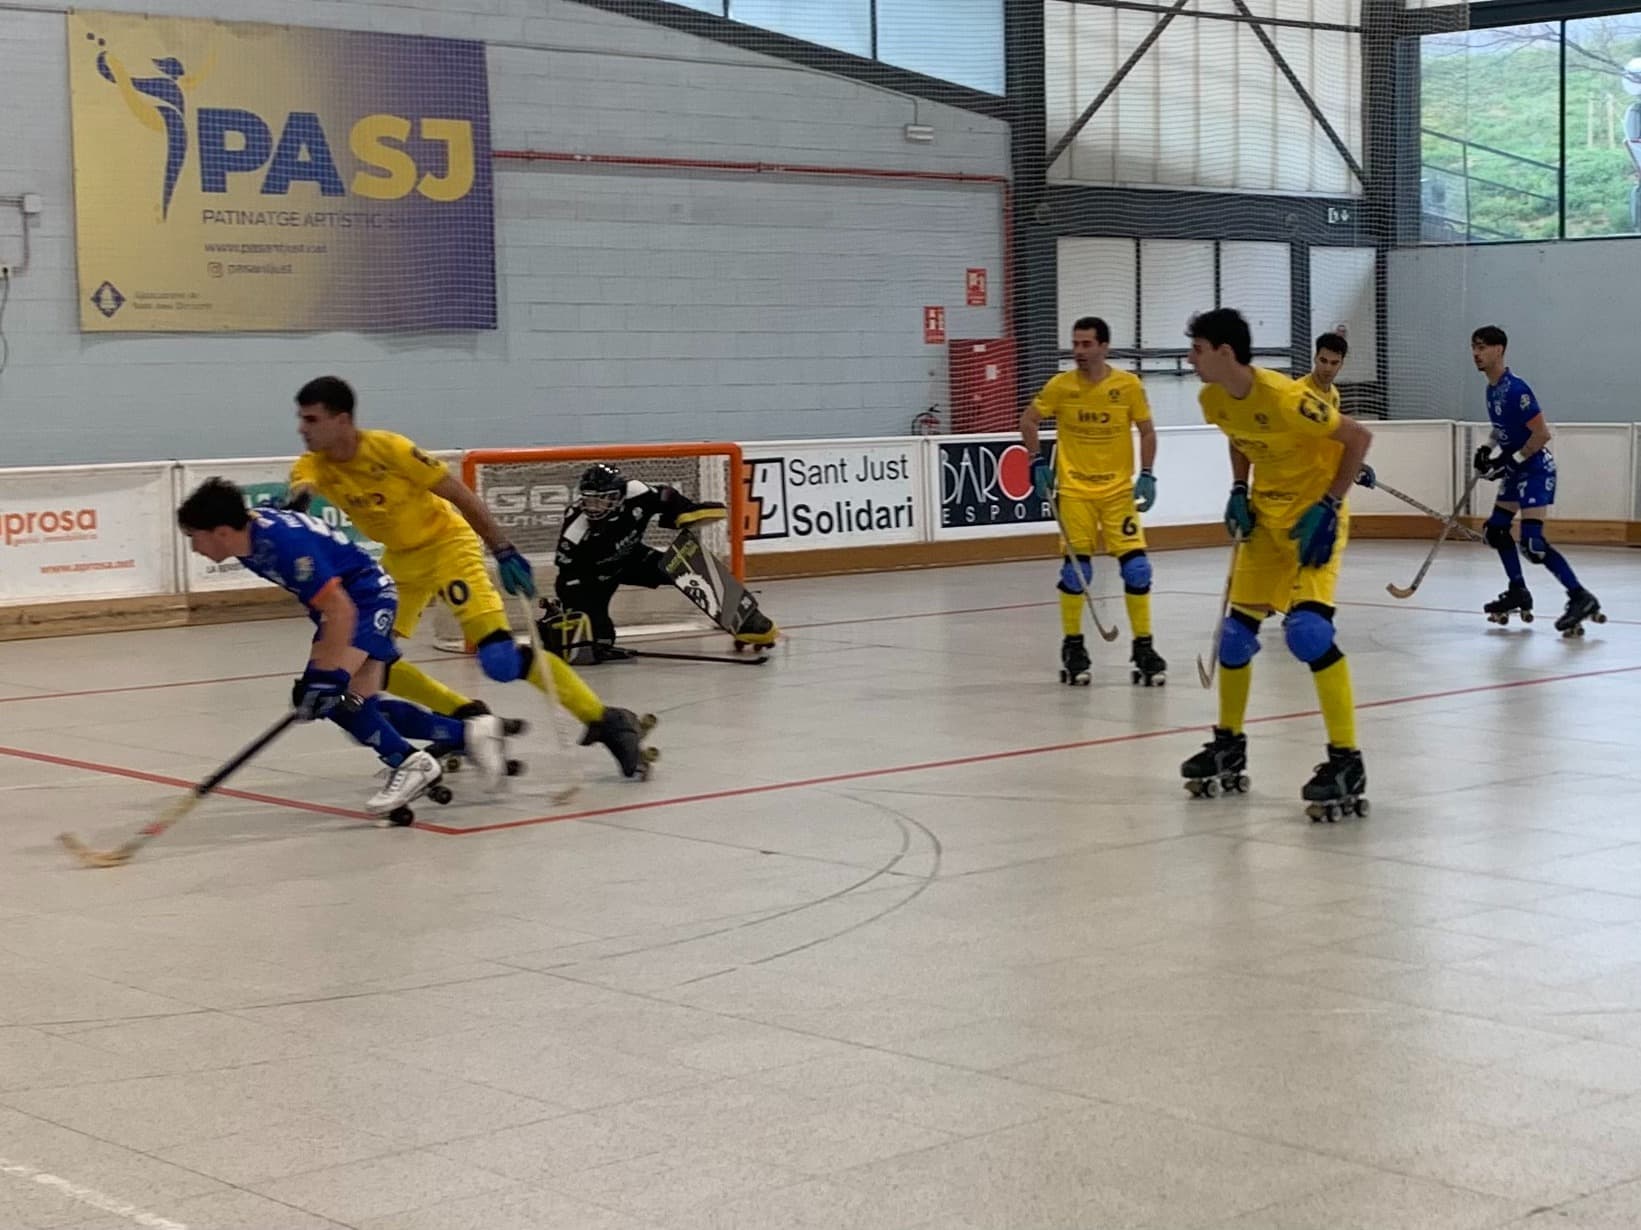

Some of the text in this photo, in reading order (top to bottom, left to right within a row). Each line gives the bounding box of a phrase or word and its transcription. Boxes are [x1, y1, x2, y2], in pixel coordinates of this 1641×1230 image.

[198, 108, 476, 202] PASJ
[202, 208, 299, 227] PATINATGE
[789, 454, 909, 486] Sant Just
[0, 508, 97, 545] prosa
[792, 496, 914, 536] Solidari
[1122, 516, 1137, 537] 6
